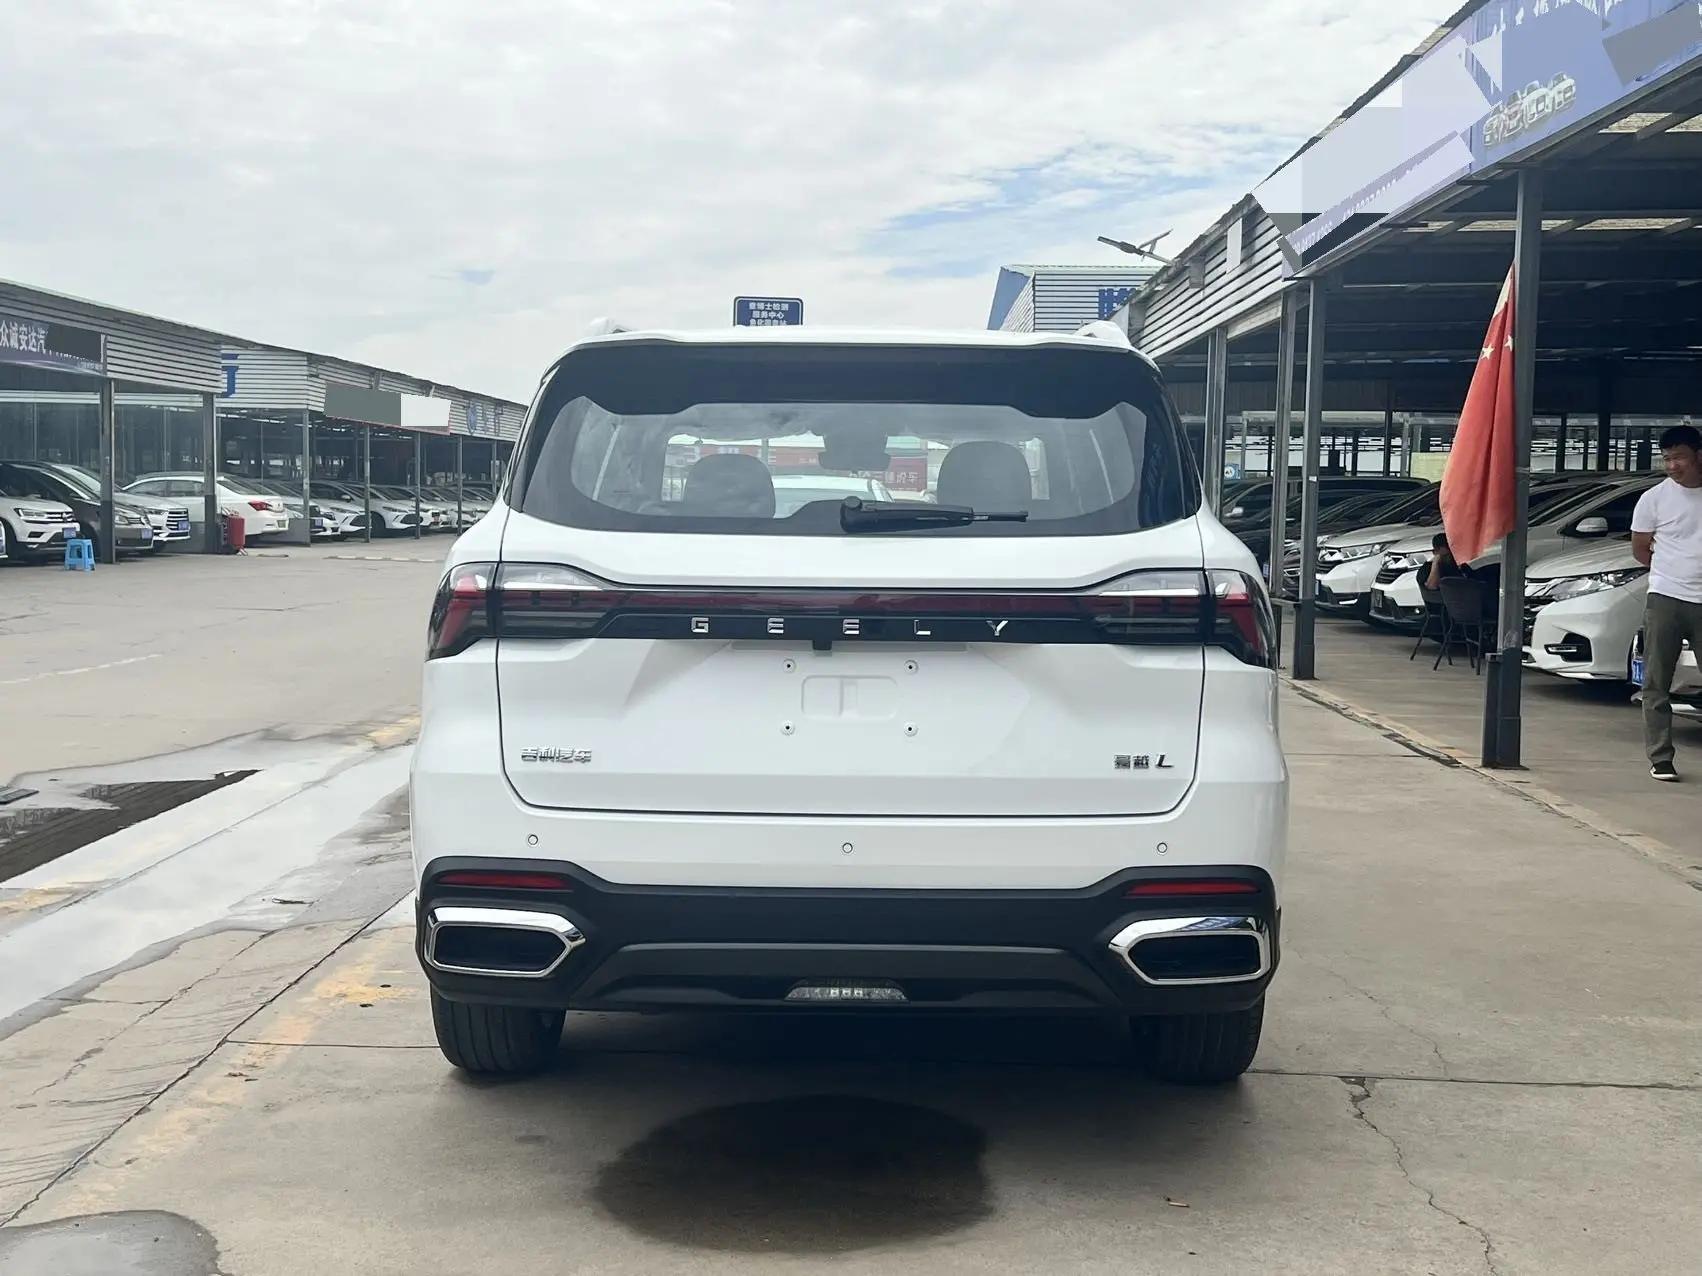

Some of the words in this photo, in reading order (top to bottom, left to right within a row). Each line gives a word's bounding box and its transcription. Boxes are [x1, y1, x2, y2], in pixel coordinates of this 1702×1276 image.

[752, 310, 785, 319] 服务中心
[691, 617, 1008, 637] GEELY
[521, 746, 592, 763] 吉利汽车
[1155, 753, 1174, 768] L
